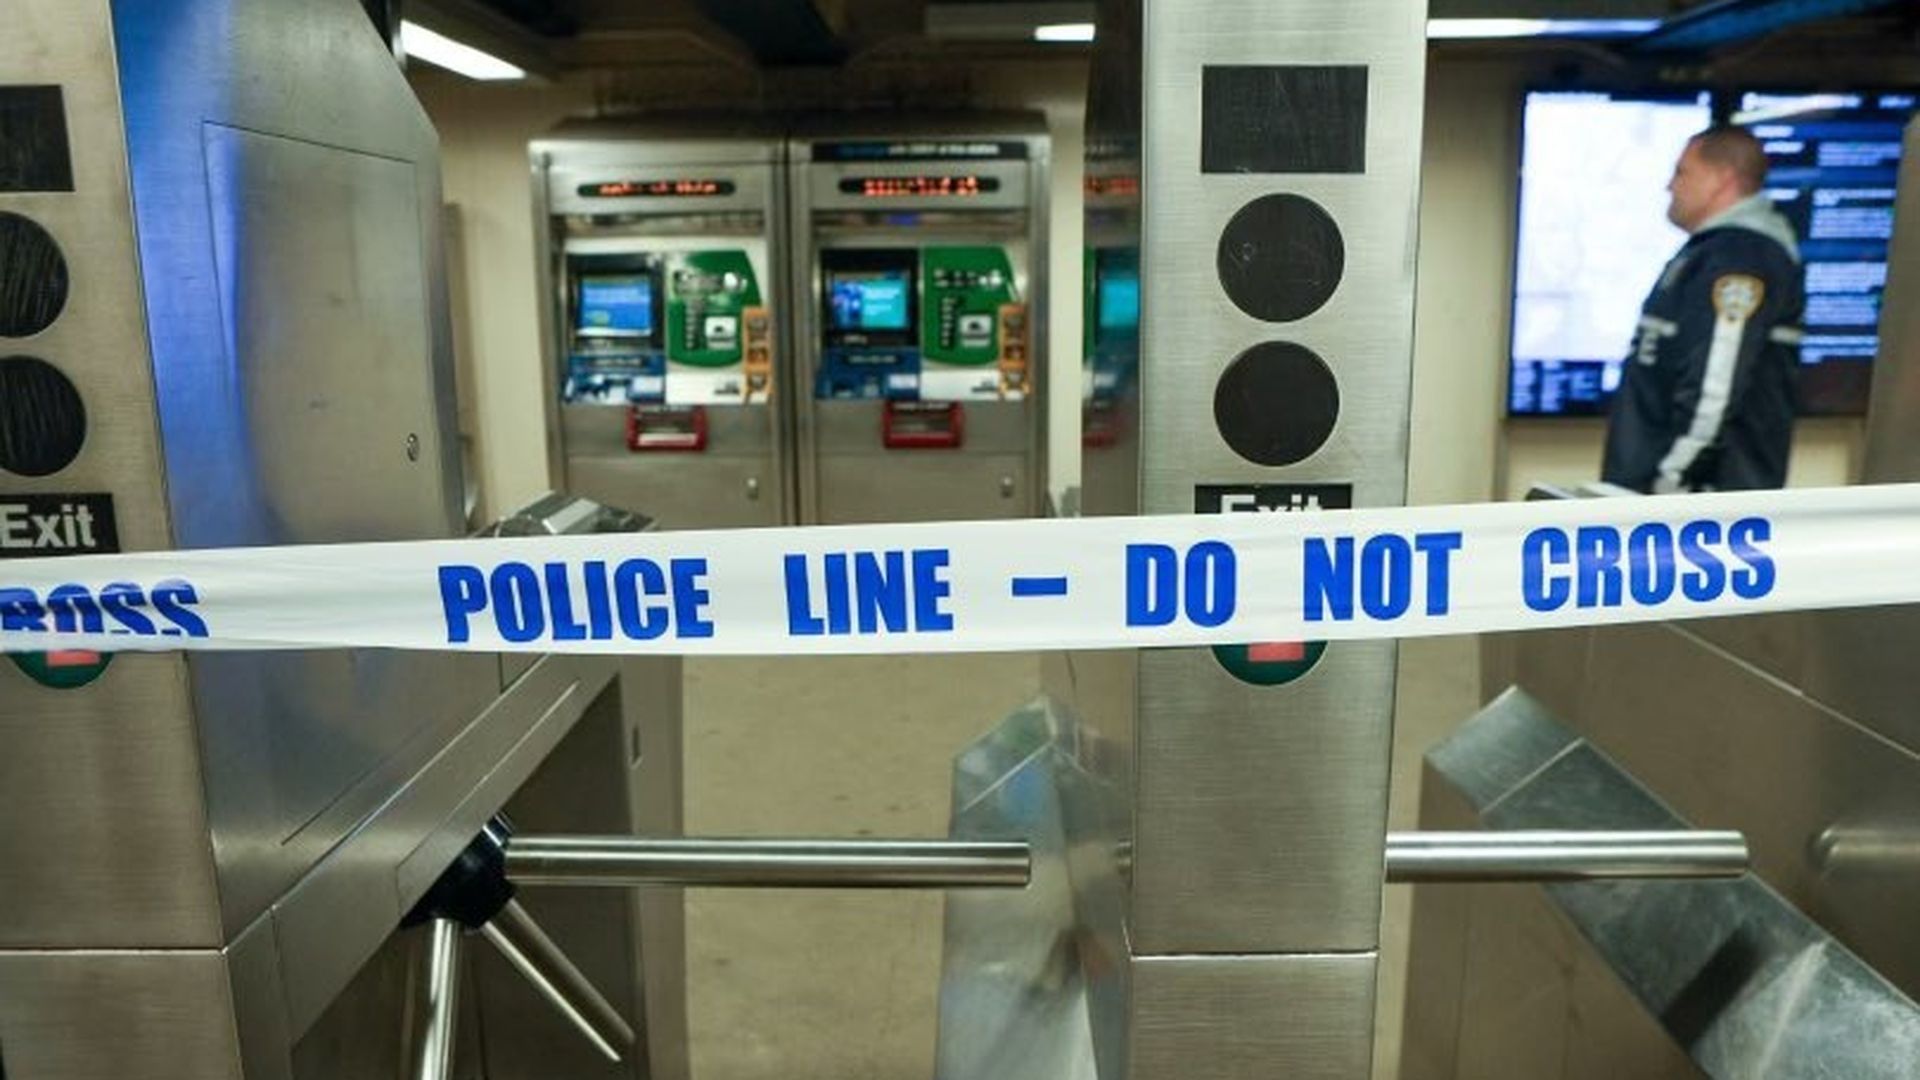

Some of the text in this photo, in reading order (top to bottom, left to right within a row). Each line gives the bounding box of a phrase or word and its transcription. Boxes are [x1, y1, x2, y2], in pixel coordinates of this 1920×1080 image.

[0, 503, 96, 548] Exit
[439, 558, 714, 643] POLICE
[784, 548, 954, 636] LINE
[1125, 540, 1237, 628] DO
[1303, 531, 1463, 622] NOT
[1522, 516, 1776, 612] CROSS
